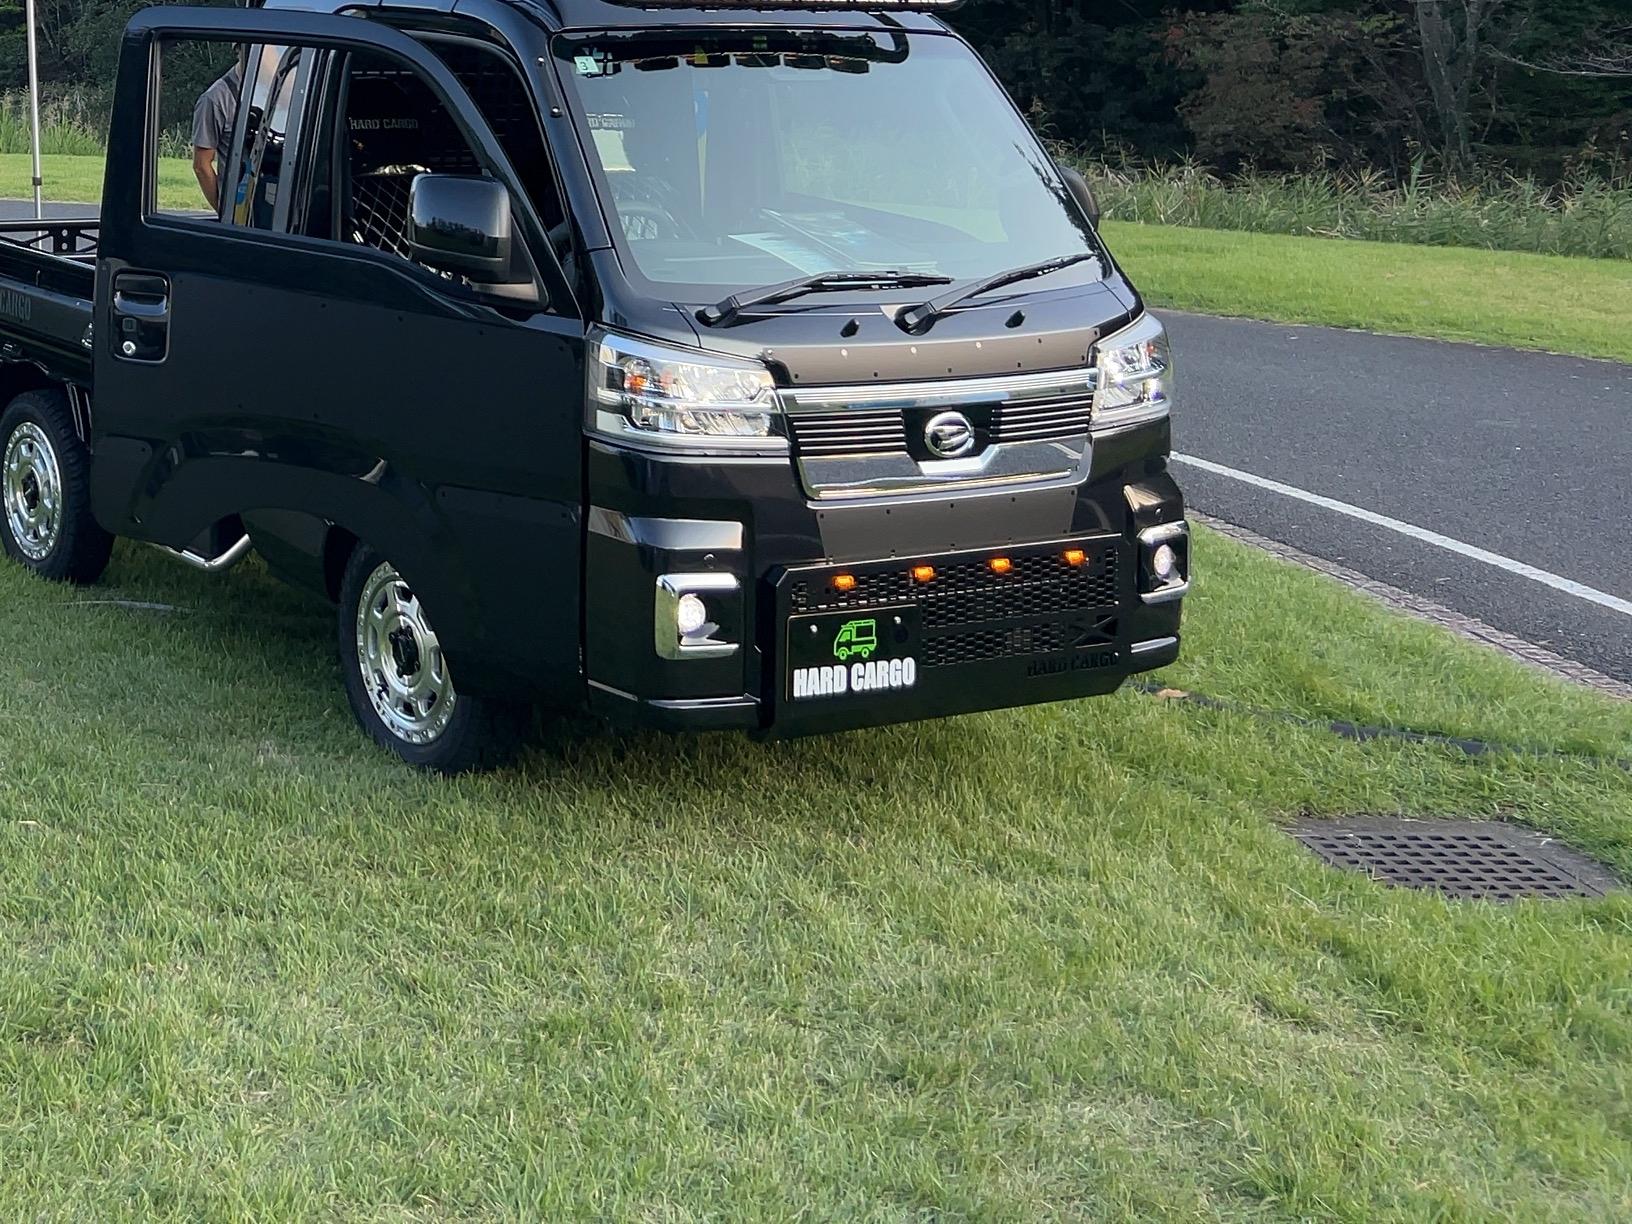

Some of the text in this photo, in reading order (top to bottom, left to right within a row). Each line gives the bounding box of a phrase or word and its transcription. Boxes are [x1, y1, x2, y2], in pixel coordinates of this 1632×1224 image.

[350, 118, 418, 130] HARD CARGO
[0, 288, 31, 321] CARGO
[793, 656, 916, 698] HARD CARGO
[1028, 652, 1119, 678] HARD CARGO
